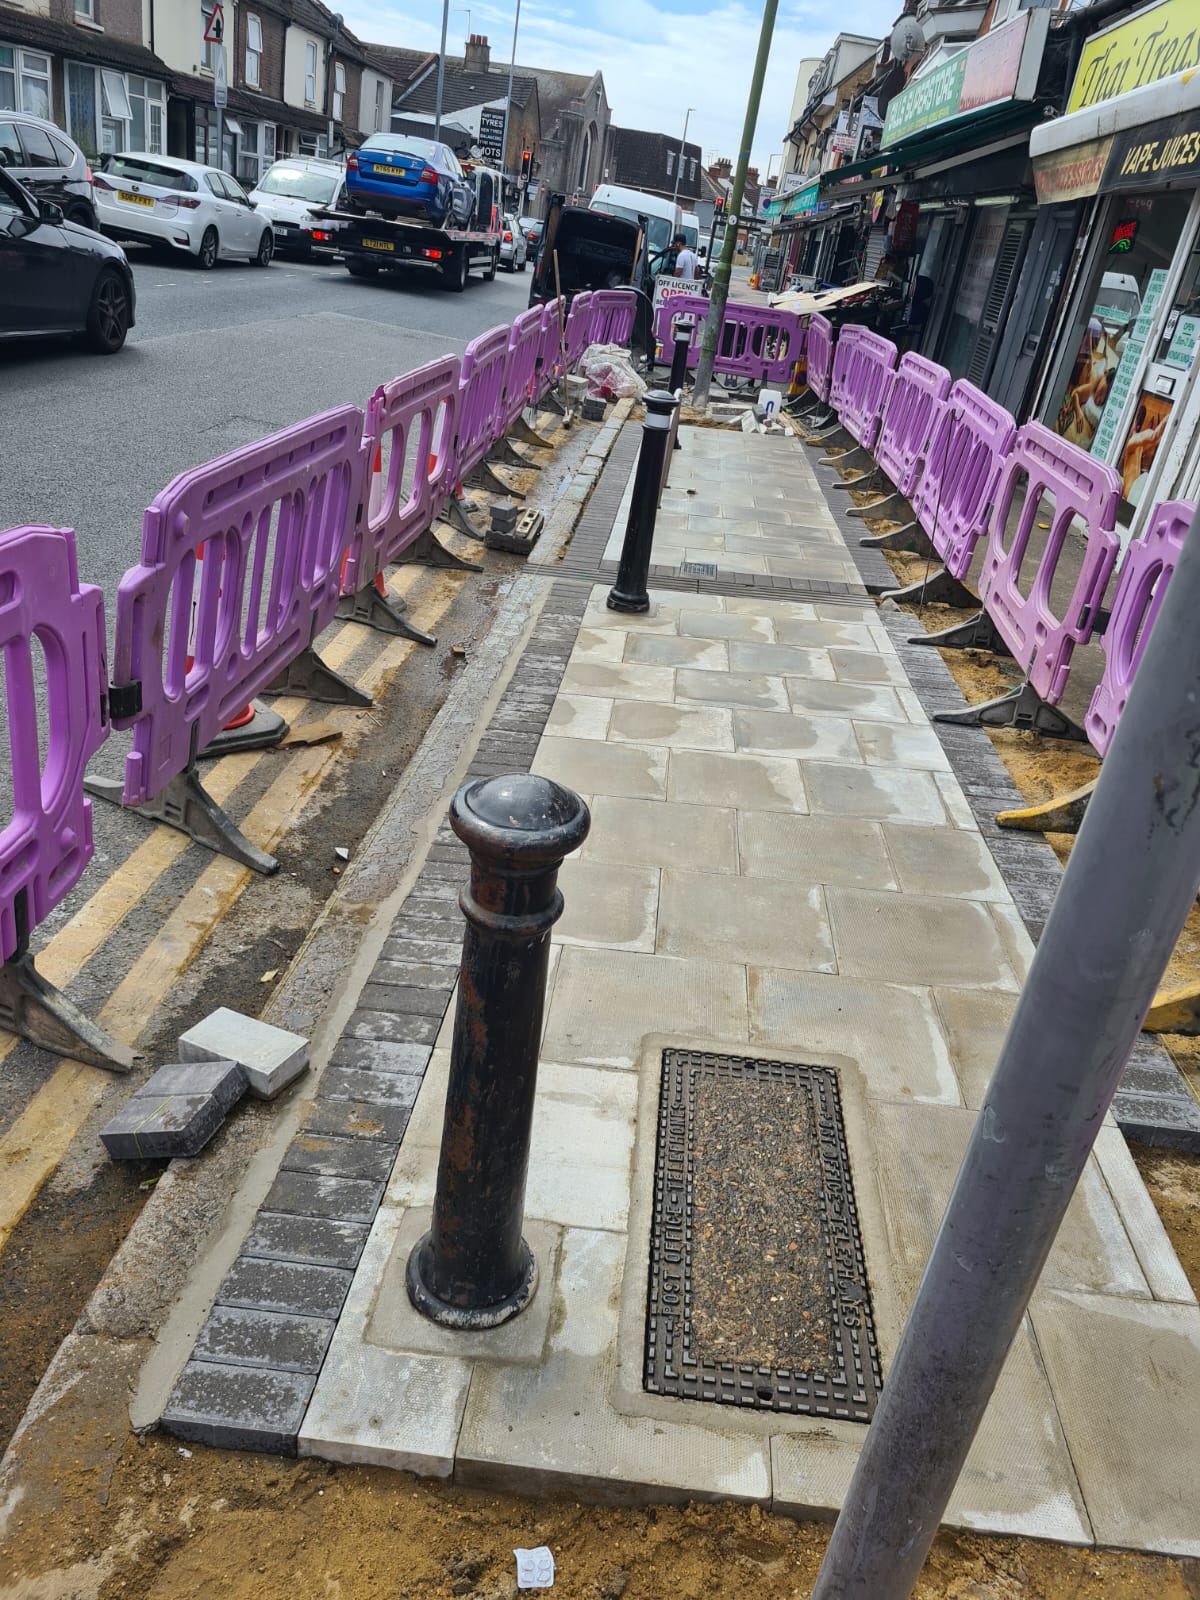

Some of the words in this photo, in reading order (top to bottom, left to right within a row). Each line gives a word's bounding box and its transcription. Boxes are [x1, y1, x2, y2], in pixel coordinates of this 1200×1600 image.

[1133, 20, 1200, 90] Trea
[481, 117, 504, 128] TYRES
[1120, 142, 1159, 175] VAPE
[1152, 131, 1200, 172] JUICES
[672, 282, 698, 291] LICENCE
[818, 1113, 837, 1146] POST
[662, 1271, 681, 1317] POST
